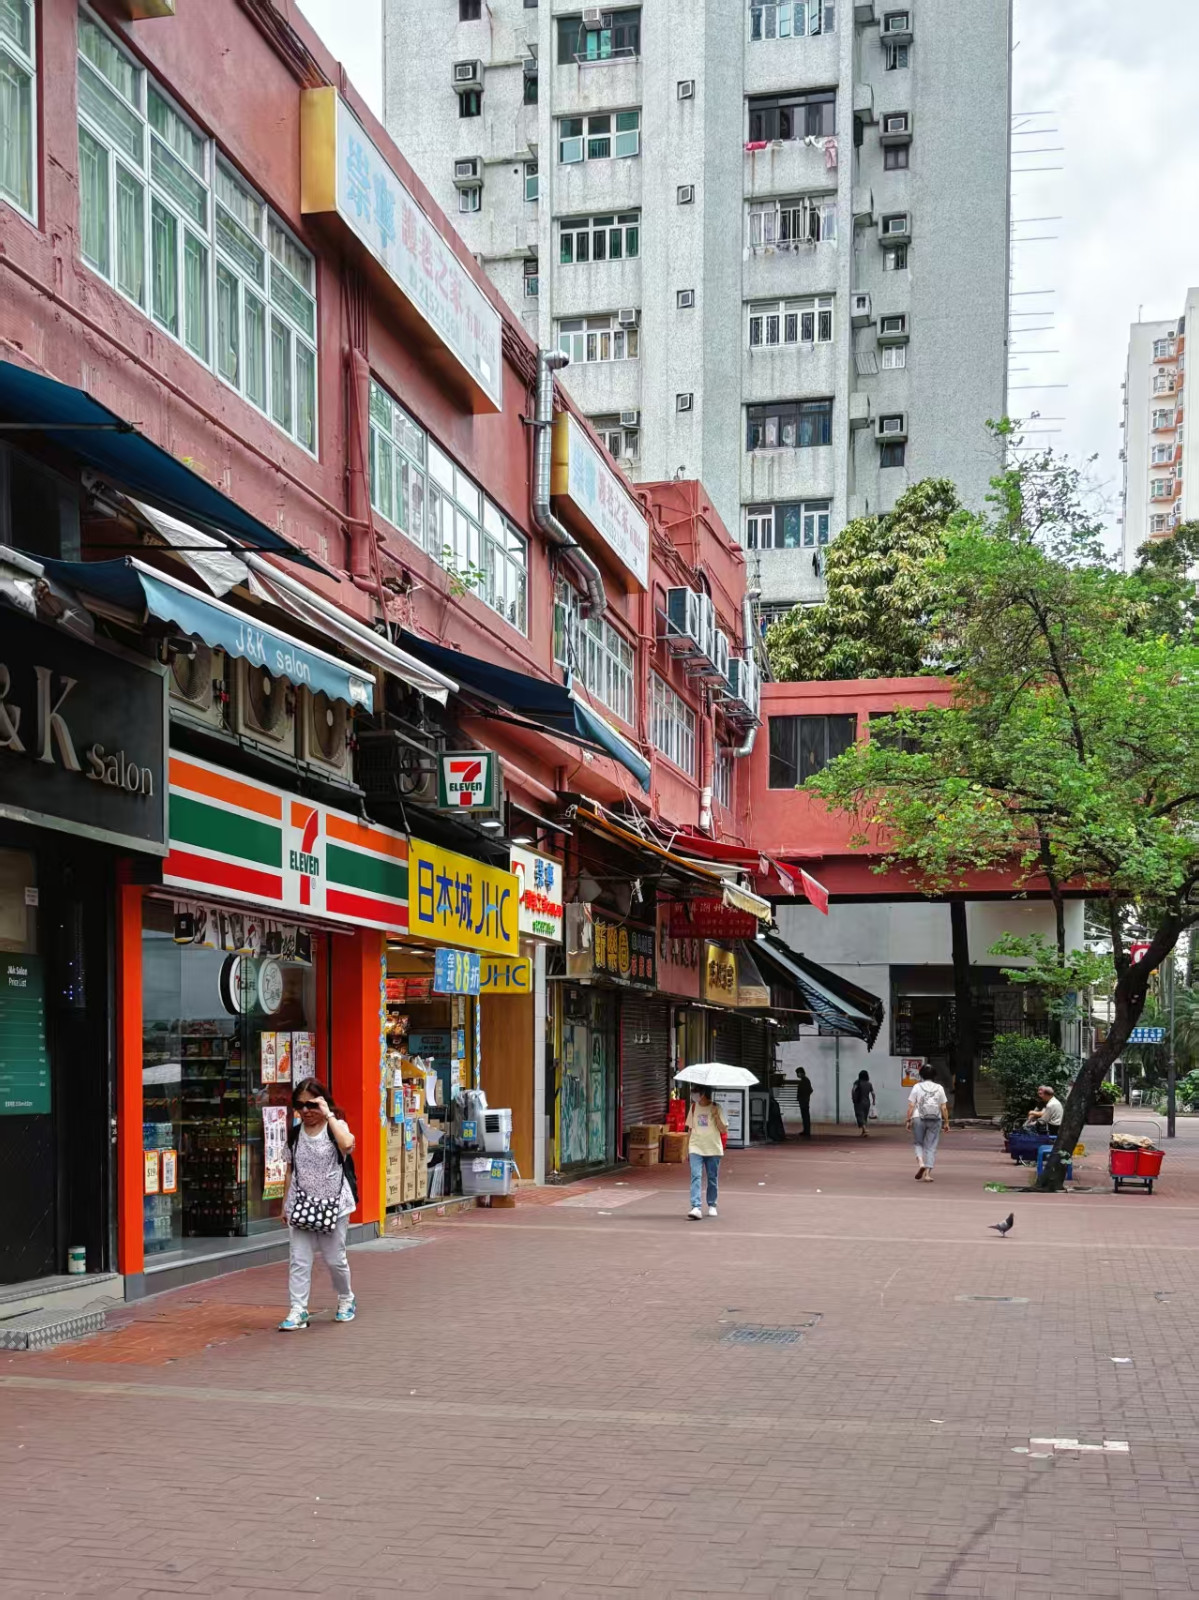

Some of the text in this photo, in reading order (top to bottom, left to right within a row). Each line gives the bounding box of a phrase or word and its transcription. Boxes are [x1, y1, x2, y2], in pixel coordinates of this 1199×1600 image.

[235, 624, 311, 682] J&K salon
[86, 744, 153, 796] Salon
[418, 859, 510, 941] 日本城 JHC
[480, 965, 526, 987] JHC
